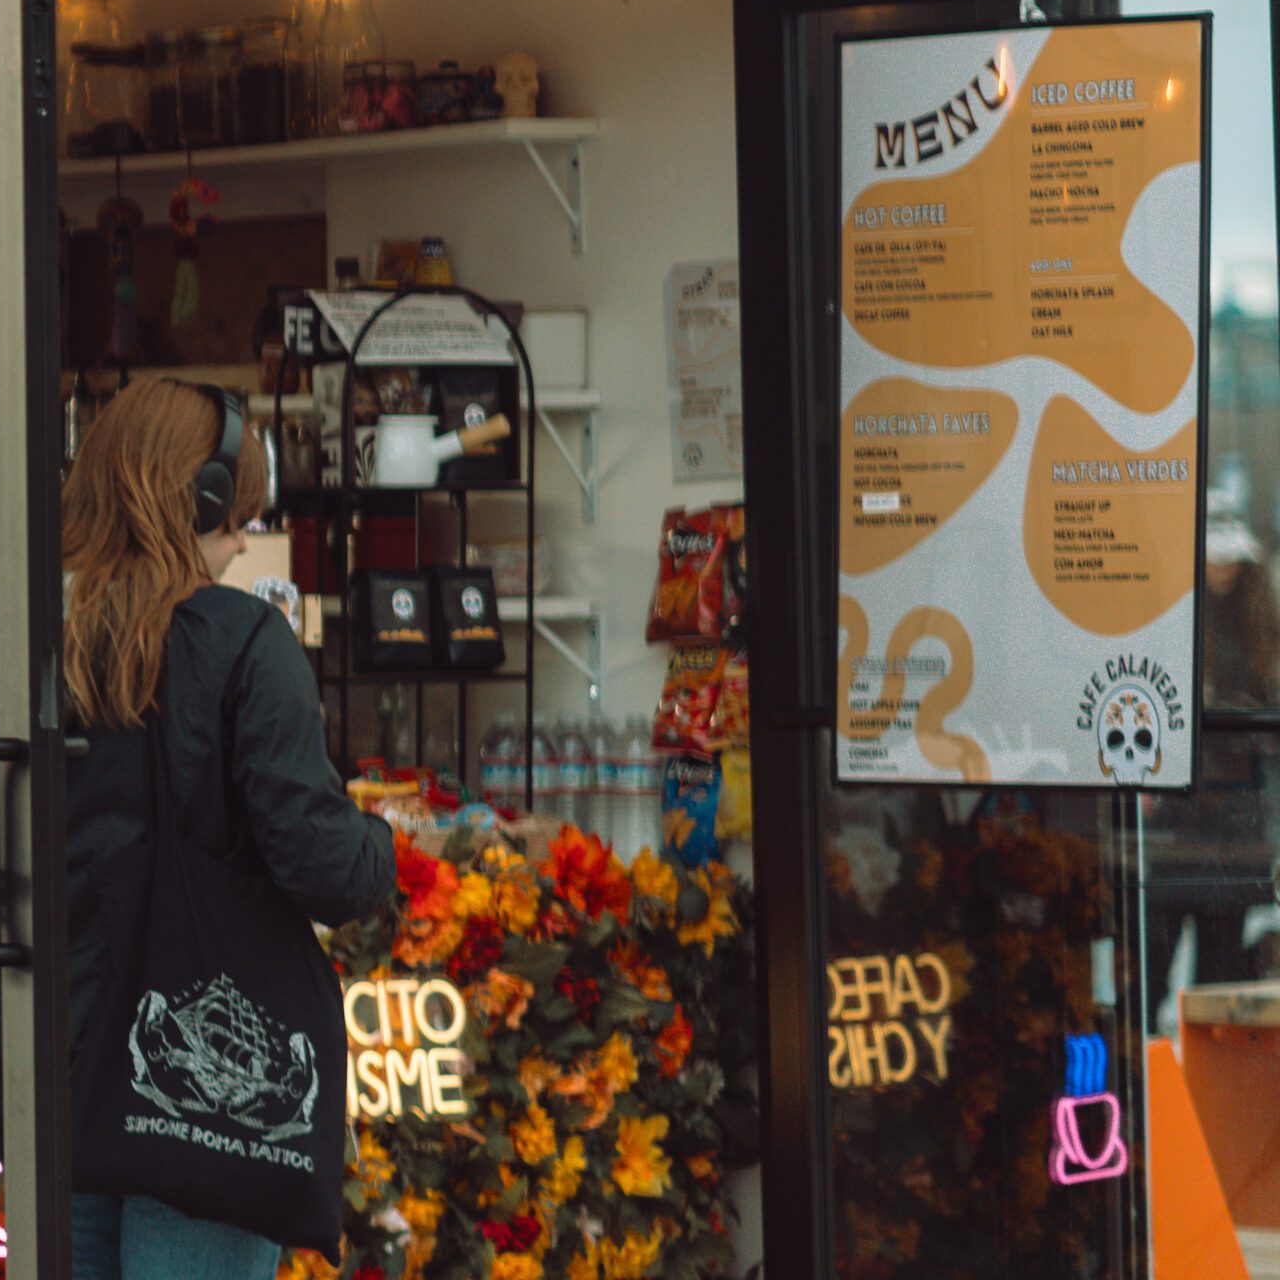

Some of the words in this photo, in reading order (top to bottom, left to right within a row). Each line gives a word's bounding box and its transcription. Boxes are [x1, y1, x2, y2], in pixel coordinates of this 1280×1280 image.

[1031, 83, 1069, 106] ICED
[1074, 79, 1135, 103] COFFEE
[874, 55, 1008, 169] MENU
[854, 207, 886, 228] HOT
[892, 204, 947, 226] COFFEE
[853, 413, 939, 437] HORCHATA
[942, 412, 991, 435] FAVES
[1052, 460, 1122, 483] MATCHA
[1125, 458, 1190, 482] VERDES
[1077, 670, 1107, 731] CAFE
[1105, 654, 1185, 732] CALAVERAS
[124, 1114, 190, 1140] SIMONE
[191, 1125, 246, 1158] ROMA
